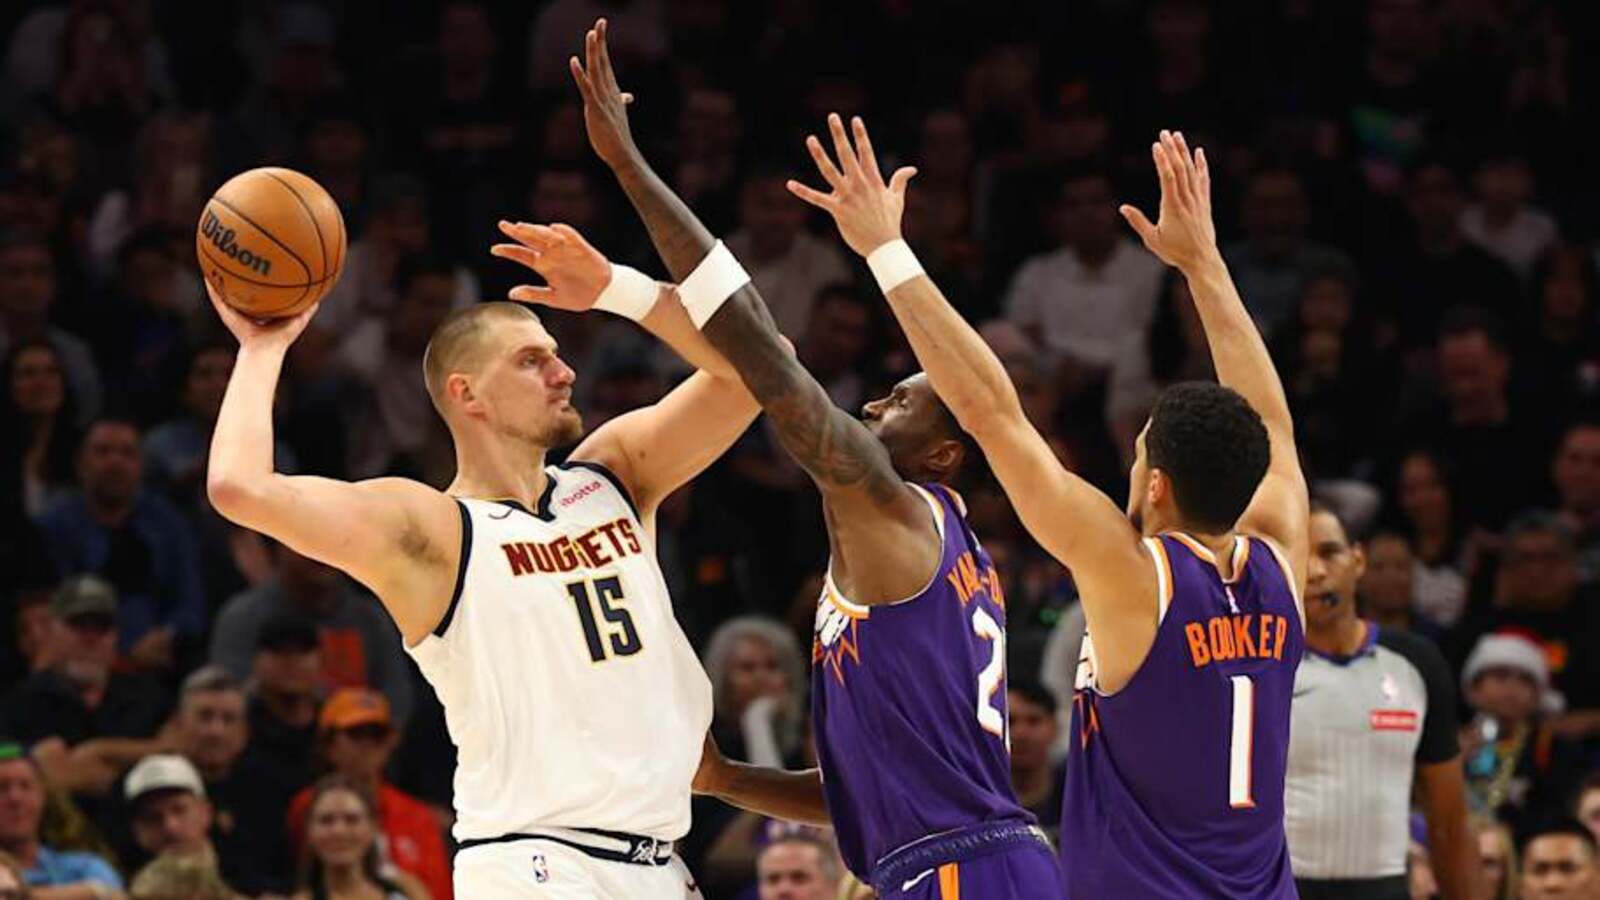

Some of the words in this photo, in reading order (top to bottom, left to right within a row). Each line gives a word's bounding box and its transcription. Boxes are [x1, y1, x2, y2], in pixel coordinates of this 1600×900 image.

[201, 207, 271, 276] Wilson
[560, 480, 602, 507] ibotta
[566, 575, 643, 663] 15
[971, 605, 1009, 750] 2
[1228, 674, 1256, 809] 1
